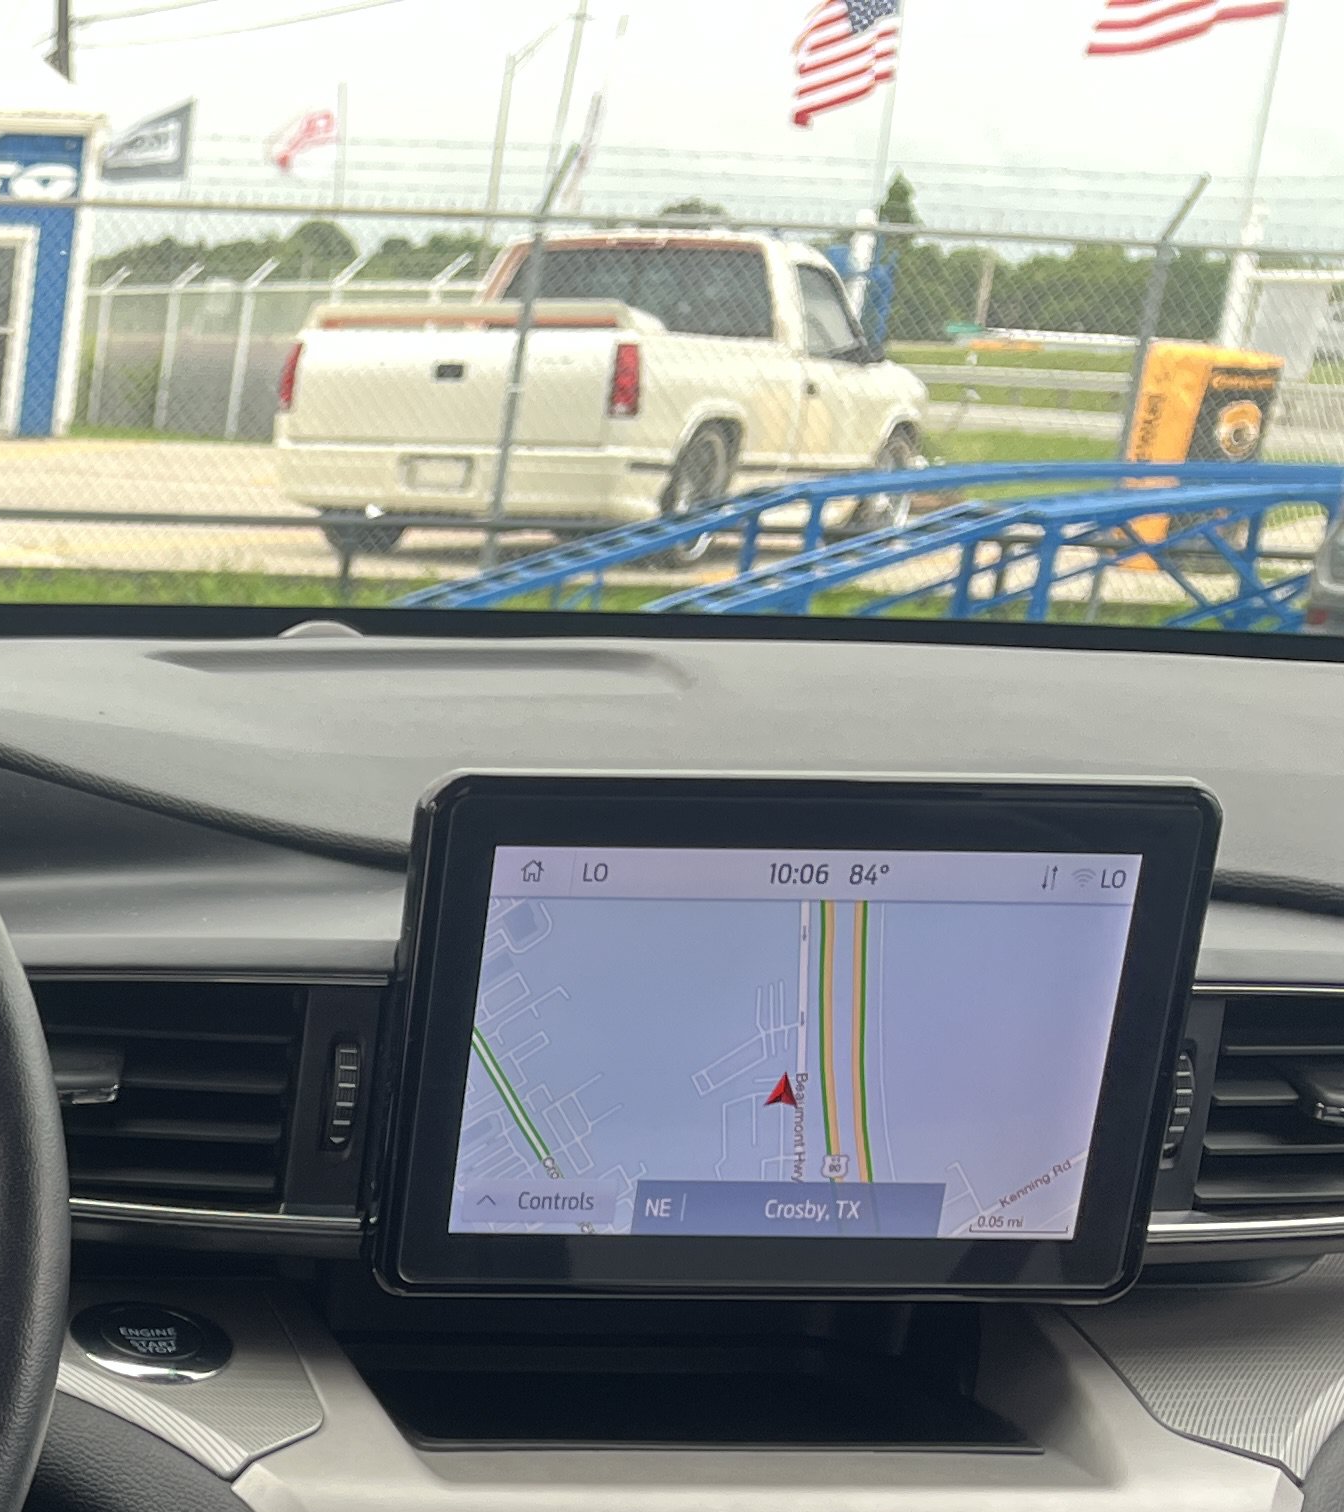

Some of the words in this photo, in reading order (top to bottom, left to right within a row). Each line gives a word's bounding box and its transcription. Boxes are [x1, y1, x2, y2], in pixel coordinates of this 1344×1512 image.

[582, 862, 609, 883] LO
[769, 862, 830, 886] 10:06
[849, 863, 891, 886] 84°
[1100, 869, 1127, 889] LO
[1051, 1158, 1073, 1178] Rd
[517, 1190, 596, 1211] Controls
[644, 1198, 672, 1218] NE
[764, 1198, 831, 1222] Crosby,
[835, 1199, 862, 1220] TX
[976, 1215, 1005, 1229] 0.05
[1007, 1215, 1025, 1229] mi
[118, 1325, 178, 1338] ENGINE
